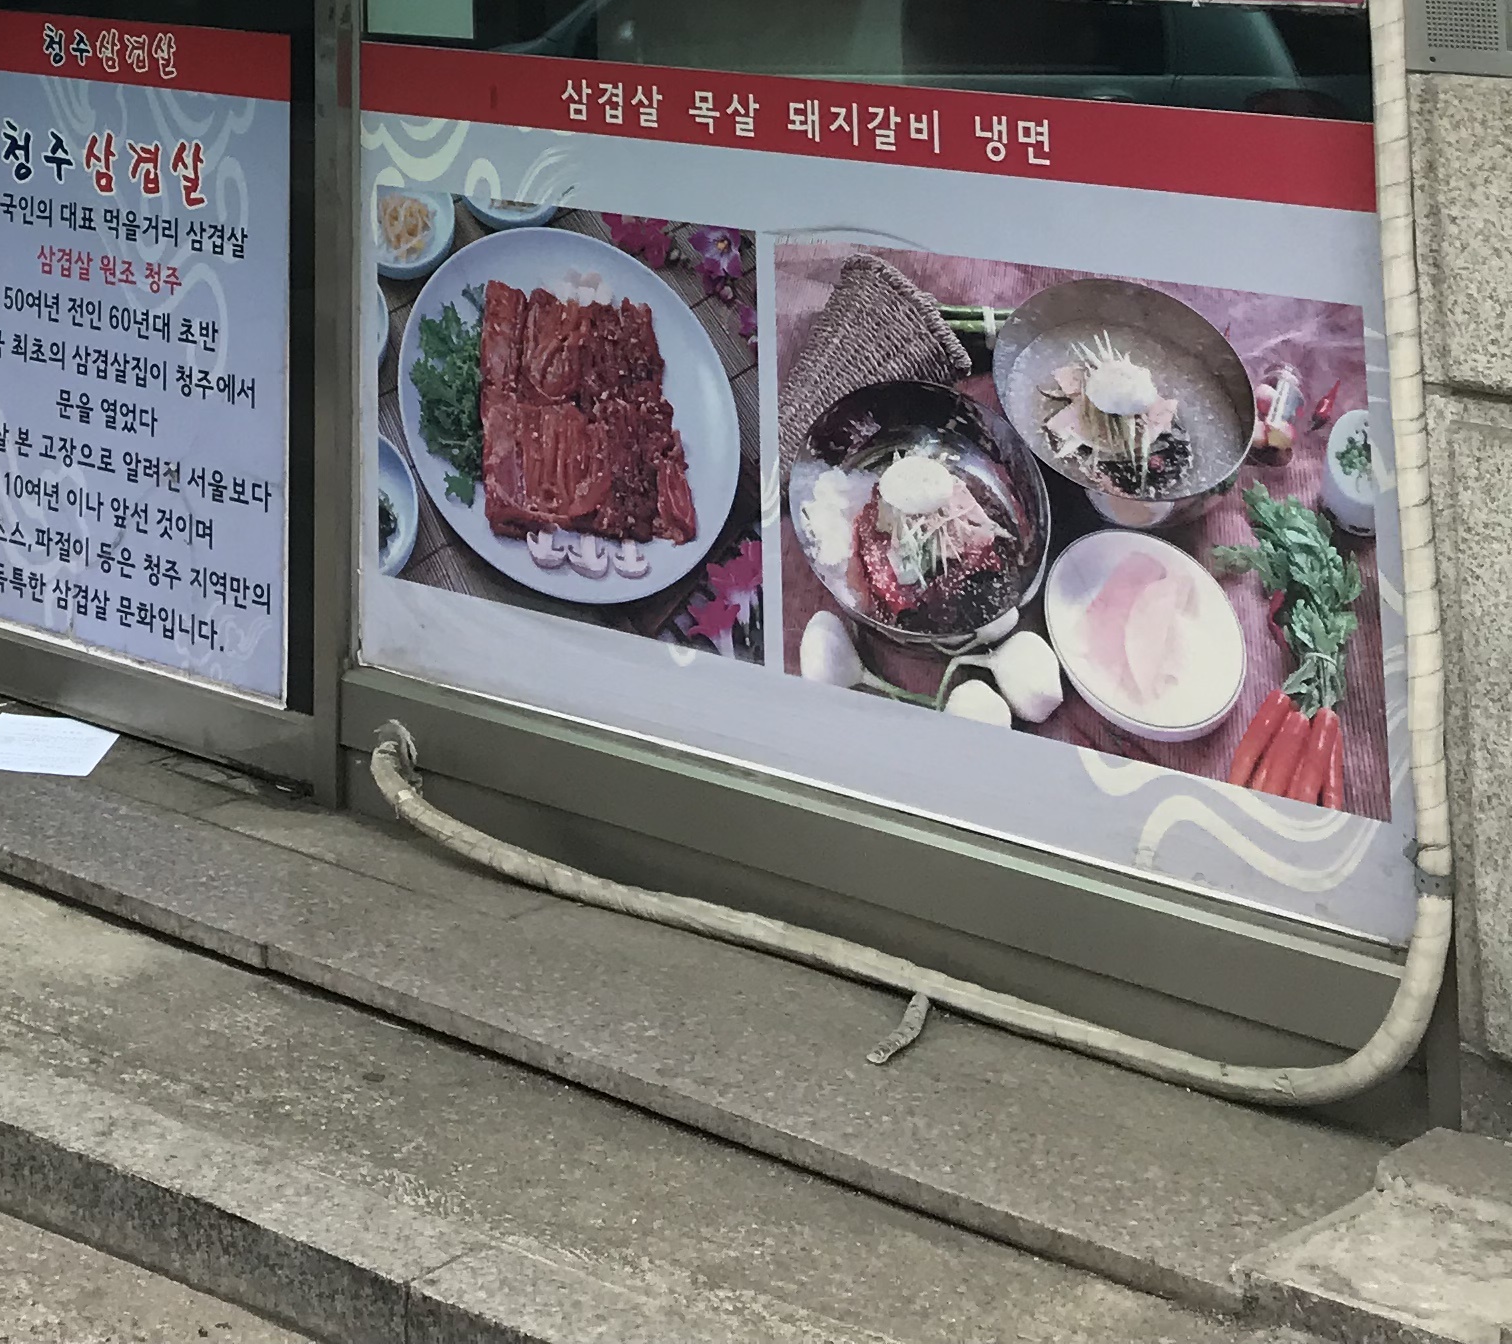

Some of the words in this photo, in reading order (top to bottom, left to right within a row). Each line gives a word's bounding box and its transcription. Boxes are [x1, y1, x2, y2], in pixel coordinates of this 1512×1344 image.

[561, 78, 663, 129] 삼겹살
[688, 89, 761, 138] 목살
[787, 98, 941, 154] 돼지갈비
[974, 115, 1052, 166] 냉면
[60, 201, 97, 232] 대표
[103, 207, 179, 248] 먹을거리
[186, 220, 249, 260] 삼겹살
[37, 243, 94, 282] 삼겹살
[99, 254, 137, 287] 원조
[144, 261, 183, 296] 청주
[3, 285, 60, 323] 50여년
[67, 295, 102, 332] 전인
[109, 305, 171, 344] 60년대
[177, 317, 219, 353] 초반
[11, 333, 66, 371] 최초의
[71, 344, 168, 392] 삼겹살집이
[175, 363, 256, 410] 청주에서
[55, 388, 94, 425] 문을
[100, 397, 159, 438] 열었다
[15, 426, 33, 458] 본
[39, 433, 117, 474] 고장으로
[187, 466, 273, 513] 서울보다
[3, 471, 60, 513] 10여년
[66, 487, 105, 522] 이나
[110, 497, 150, 535] 앞선
[156, 508, 214, 551] 것이며
[52, 578, 111, 622] 삼겹살
[116, 595, 225, 653] 문화입니다.
[96, 542, 136, 580] 등은
[143, 553, 182, 591] 청주
[189, 566, 272, 616] 지역만의
